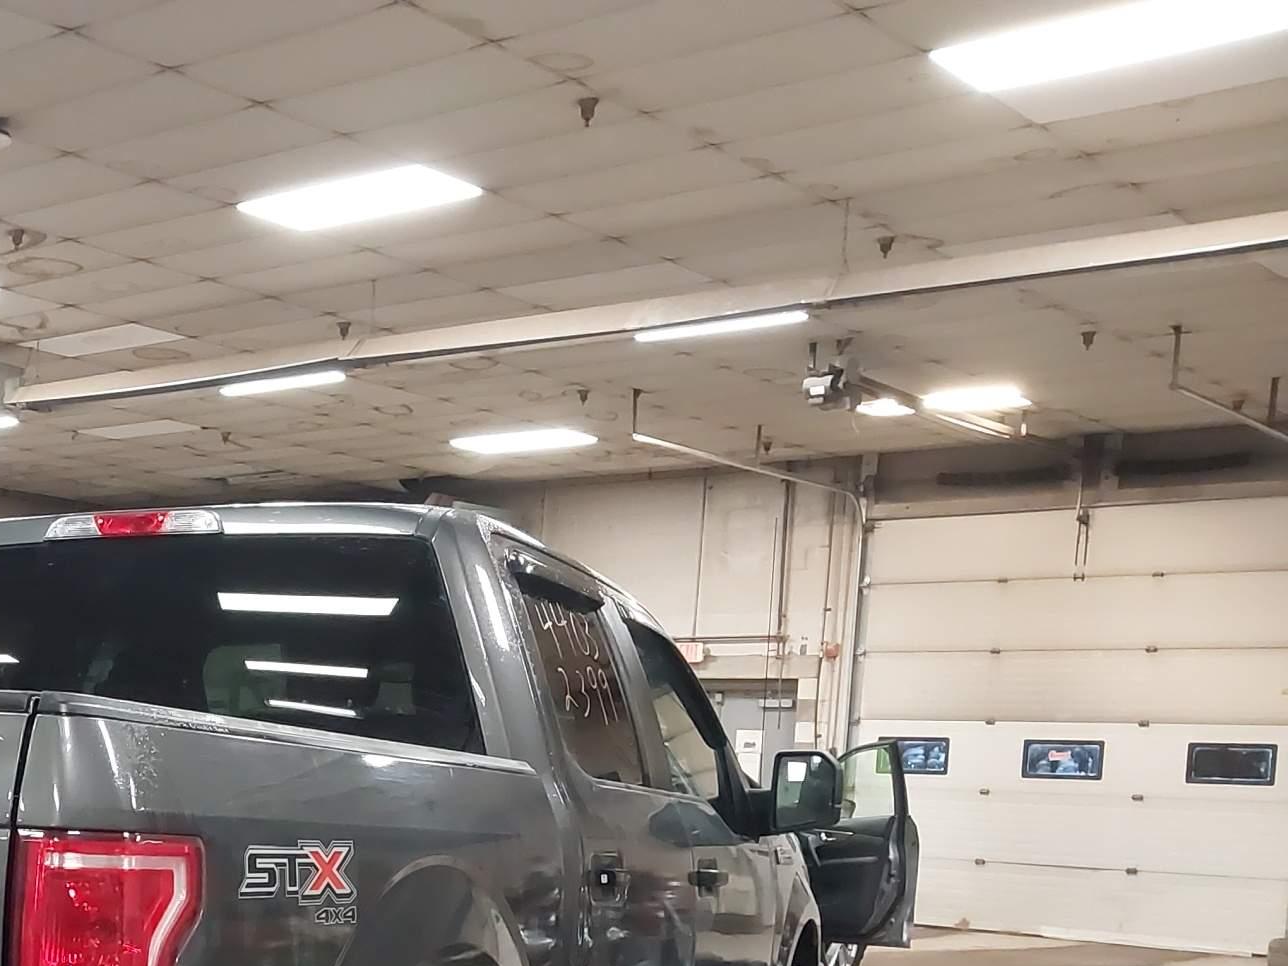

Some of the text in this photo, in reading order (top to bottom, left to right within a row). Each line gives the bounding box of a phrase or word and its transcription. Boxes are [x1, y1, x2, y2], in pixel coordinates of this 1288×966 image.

[535, 601, 599, 660] 4403
[557, 666, 618, 725] 2399
[238, 840, 357, 905] STX
